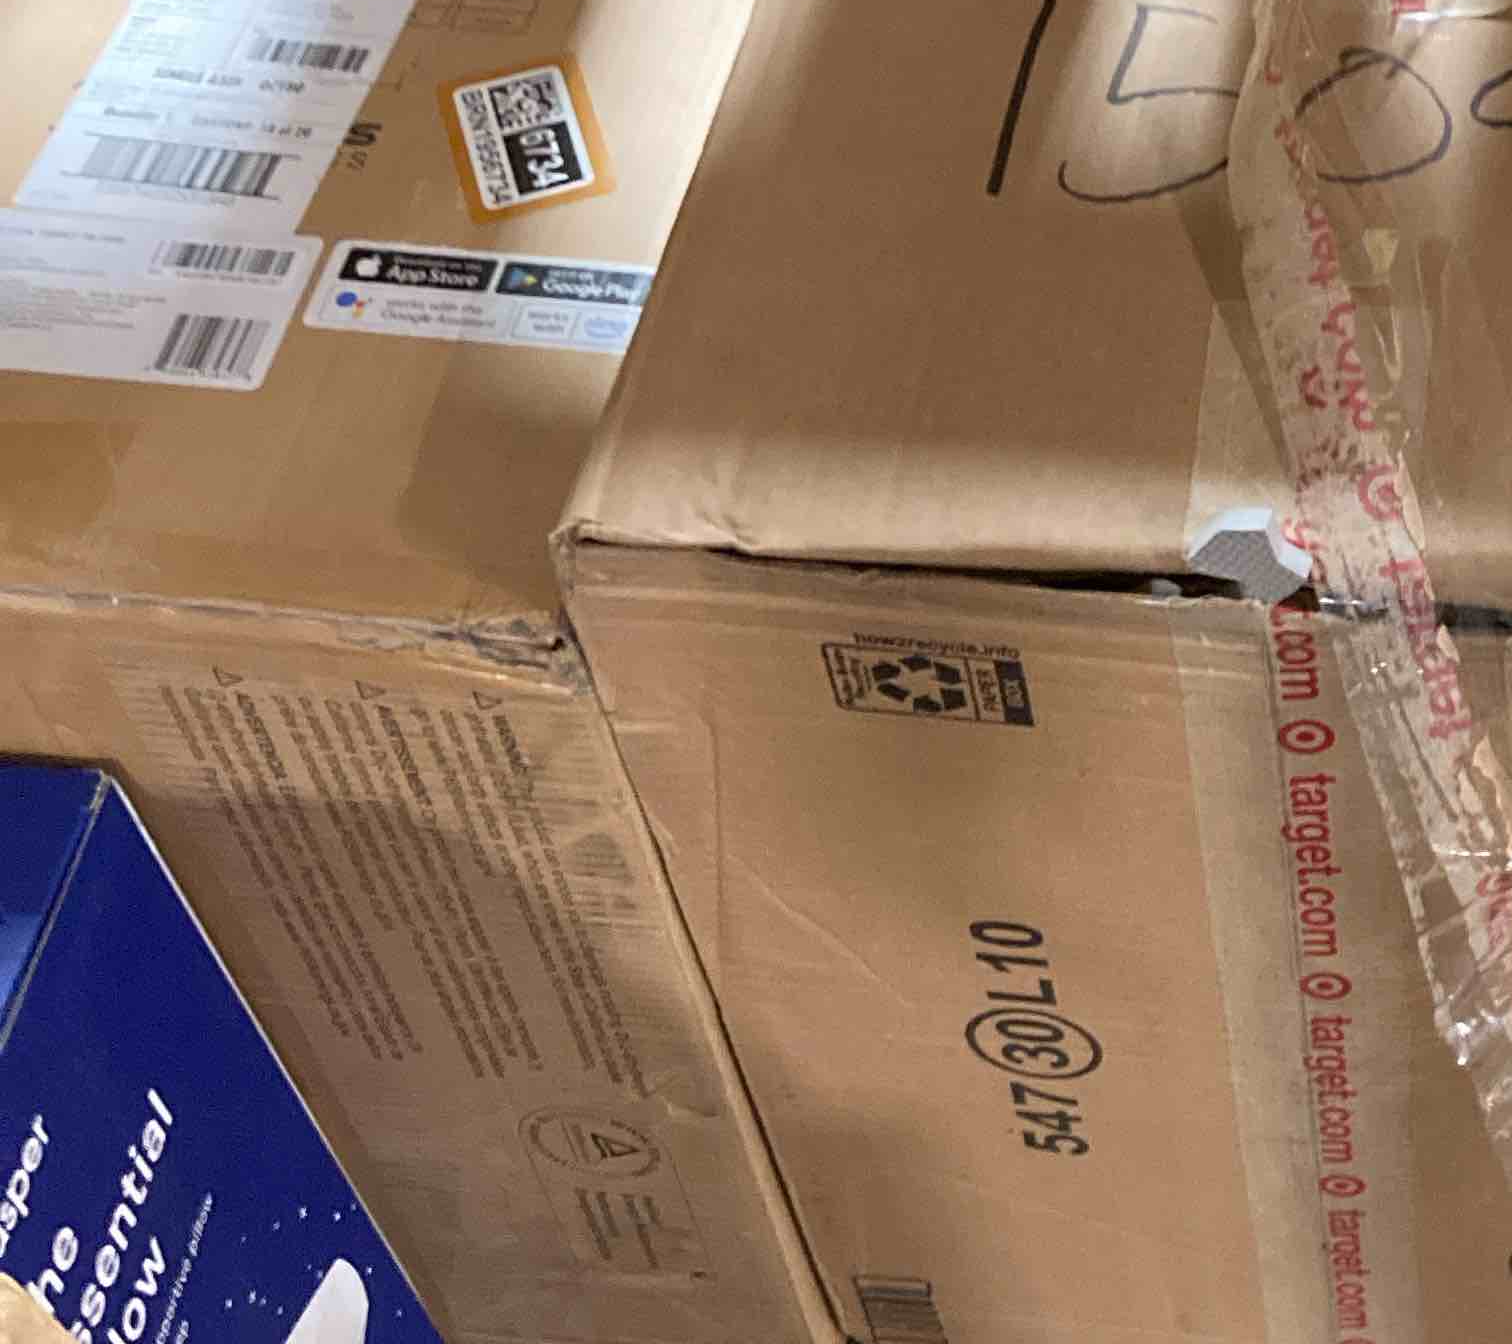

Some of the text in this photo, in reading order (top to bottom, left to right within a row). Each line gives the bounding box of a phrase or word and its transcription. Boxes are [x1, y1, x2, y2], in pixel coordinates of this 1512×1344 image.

[519, 128, 570, 188] 6734
[385, 265, 480, 287] App Store
[1282, 773, 1342, 957] target.com
[995, 1018, 1070, 1068] 30
[1303, 1015, 1357, 1163] target.com
[188, 1190, 213, 1257] pillow
[1326, 1209, 1372, 1329] target.com
